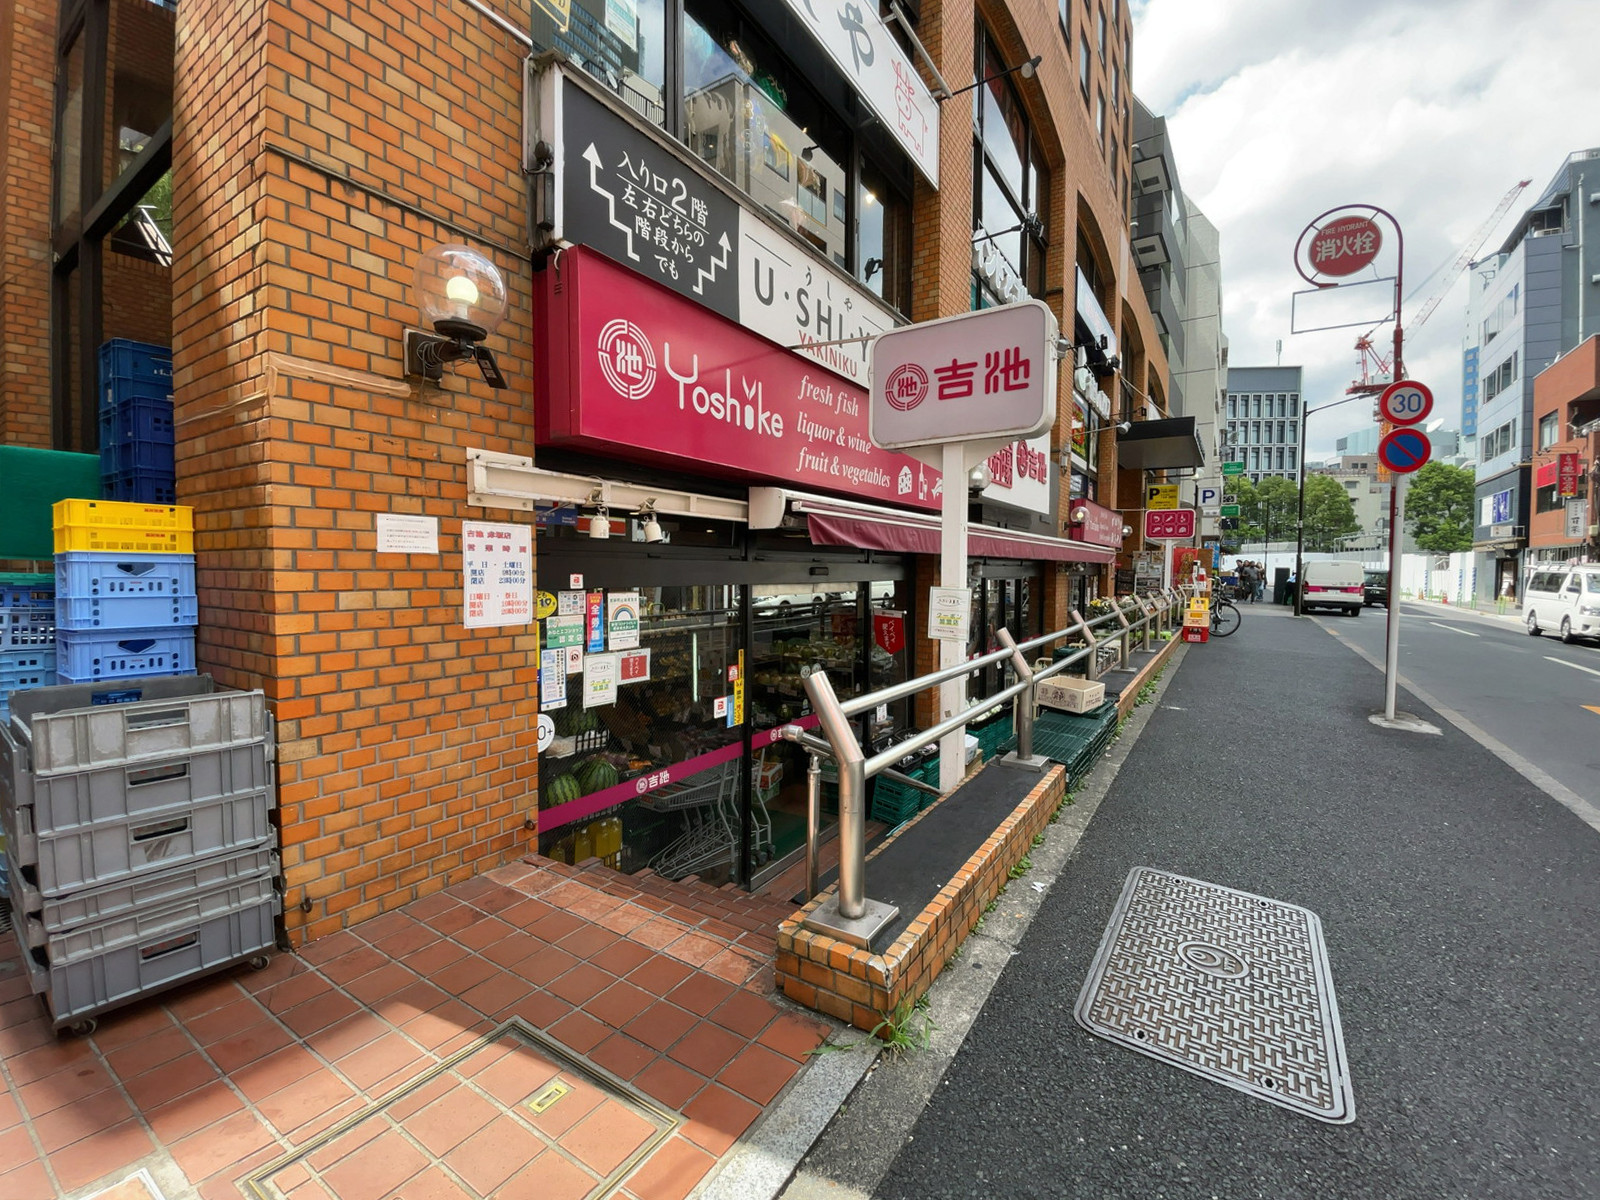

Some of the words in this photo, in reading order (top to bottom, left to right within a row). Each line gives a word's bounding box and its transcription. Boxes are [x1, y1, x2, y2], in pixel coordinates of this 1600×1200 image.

[621, 183, 705, 247] 左右どちらの
[1320, 227, 1336, 236] FIRE
[1337, 221, 1369, 233] HYDRANT
[635, 214, 694, 263] 階段から
[1316, 230, 1376, 263] 消火栓
[654, 253, 679, 280] でも
[799, 329, 858, 378] YAKINIKU
[934, 346, 1031, 401] 吉池
[664, 342, 784, 438] Yoshike
[798, 374, 833, 407] fresh
[834, 391, 859, 417] fish
[1392, 392, 1422, 414] 30
[797, 411, 836, 443] liquor
[836, 426, 846, 447] &
[848, 432, 872, 454] wine
[796, 446, 829, 473] fruit
[830, 455, 840, 476] &
[842, 464, 891, 488] vegetables
[1149, 487, 1160, 501] P
[1202, 489, 1216, 504] P
